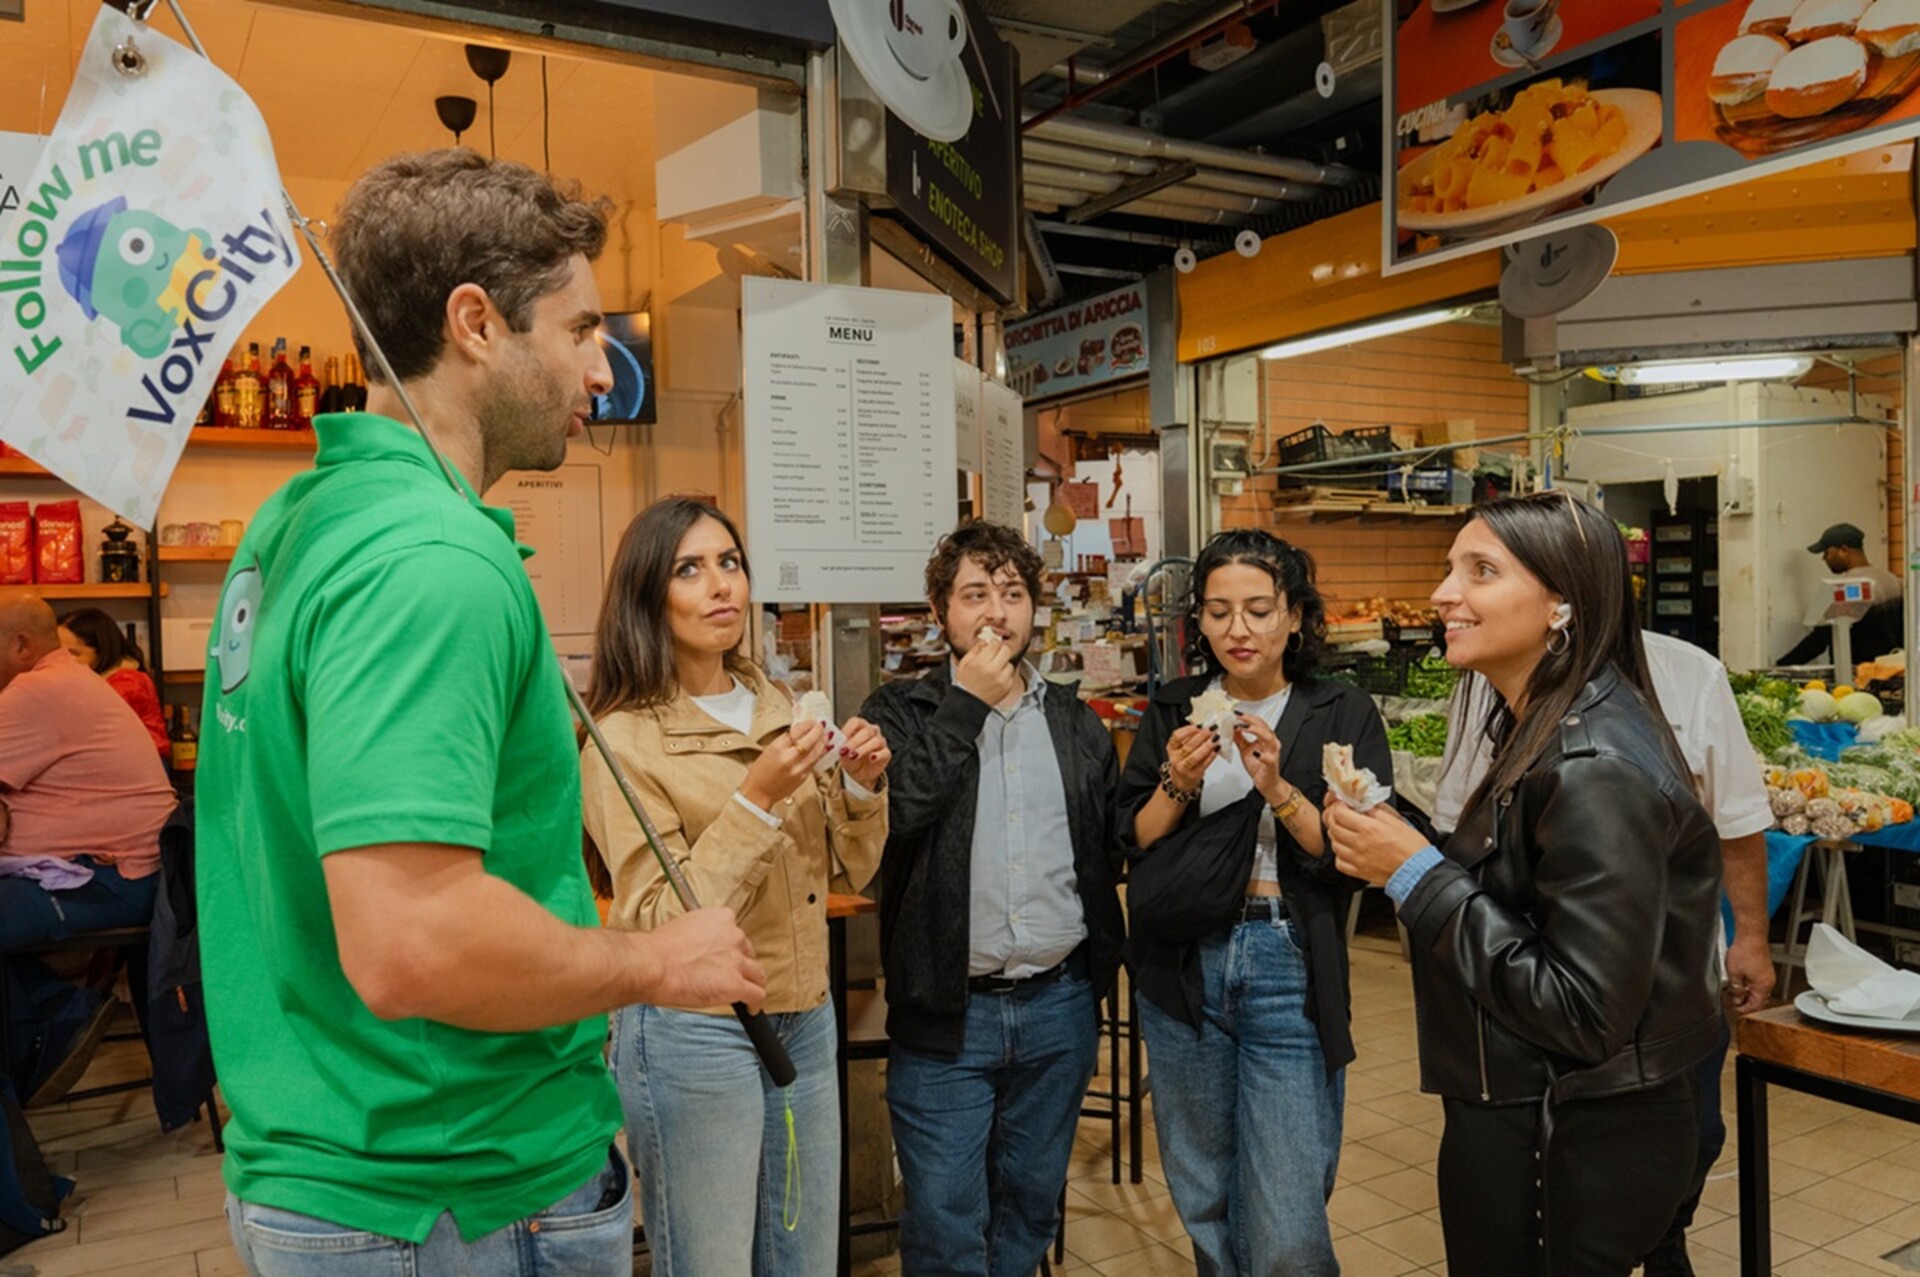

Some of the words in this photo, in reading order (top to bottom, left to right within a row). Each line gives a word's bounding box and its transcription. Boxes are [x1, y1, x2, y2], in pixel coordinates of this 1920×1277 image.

[1396, 98, 1447, 137] CUCINA
[928, 182, 978, 250] ENOTECA
[0, 164, 72, 376] Follow
[77, 128, 162, 181] me
[125, 207, 294, 425] VoxCity
[829, 326, 873, 342] MENU
[1003, 316, 1067, 351] ORCHETTA
[517, 480, 564, 489] APERITIVI
